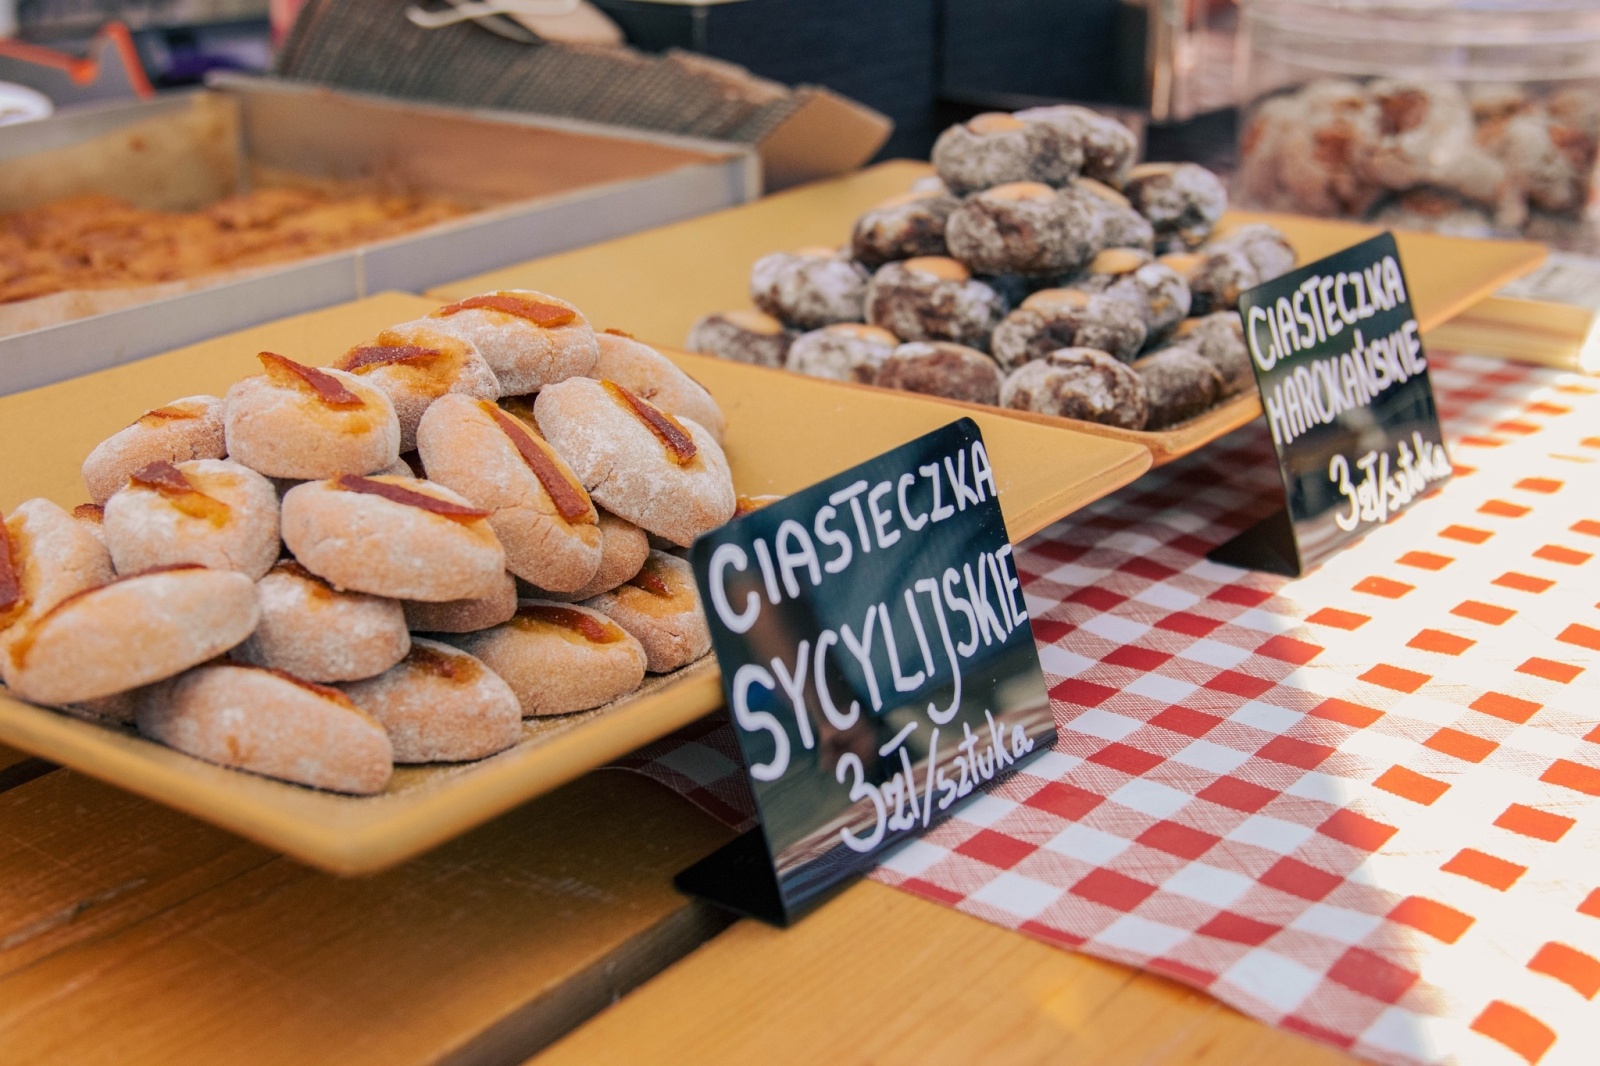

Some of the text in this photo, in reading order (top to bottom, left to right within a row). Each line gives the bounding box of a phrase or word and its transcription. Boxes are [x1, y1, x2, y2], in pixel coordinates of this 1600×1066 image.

[1248, 256, 1406, 371] CIASTECZKA
[1267, 320, 1427, 445] MAROKAŃSKIE
[709, 441, 997, 634] CIASTECZKA
[733, 543, 1028, 781] SYCYLIJSKIE
